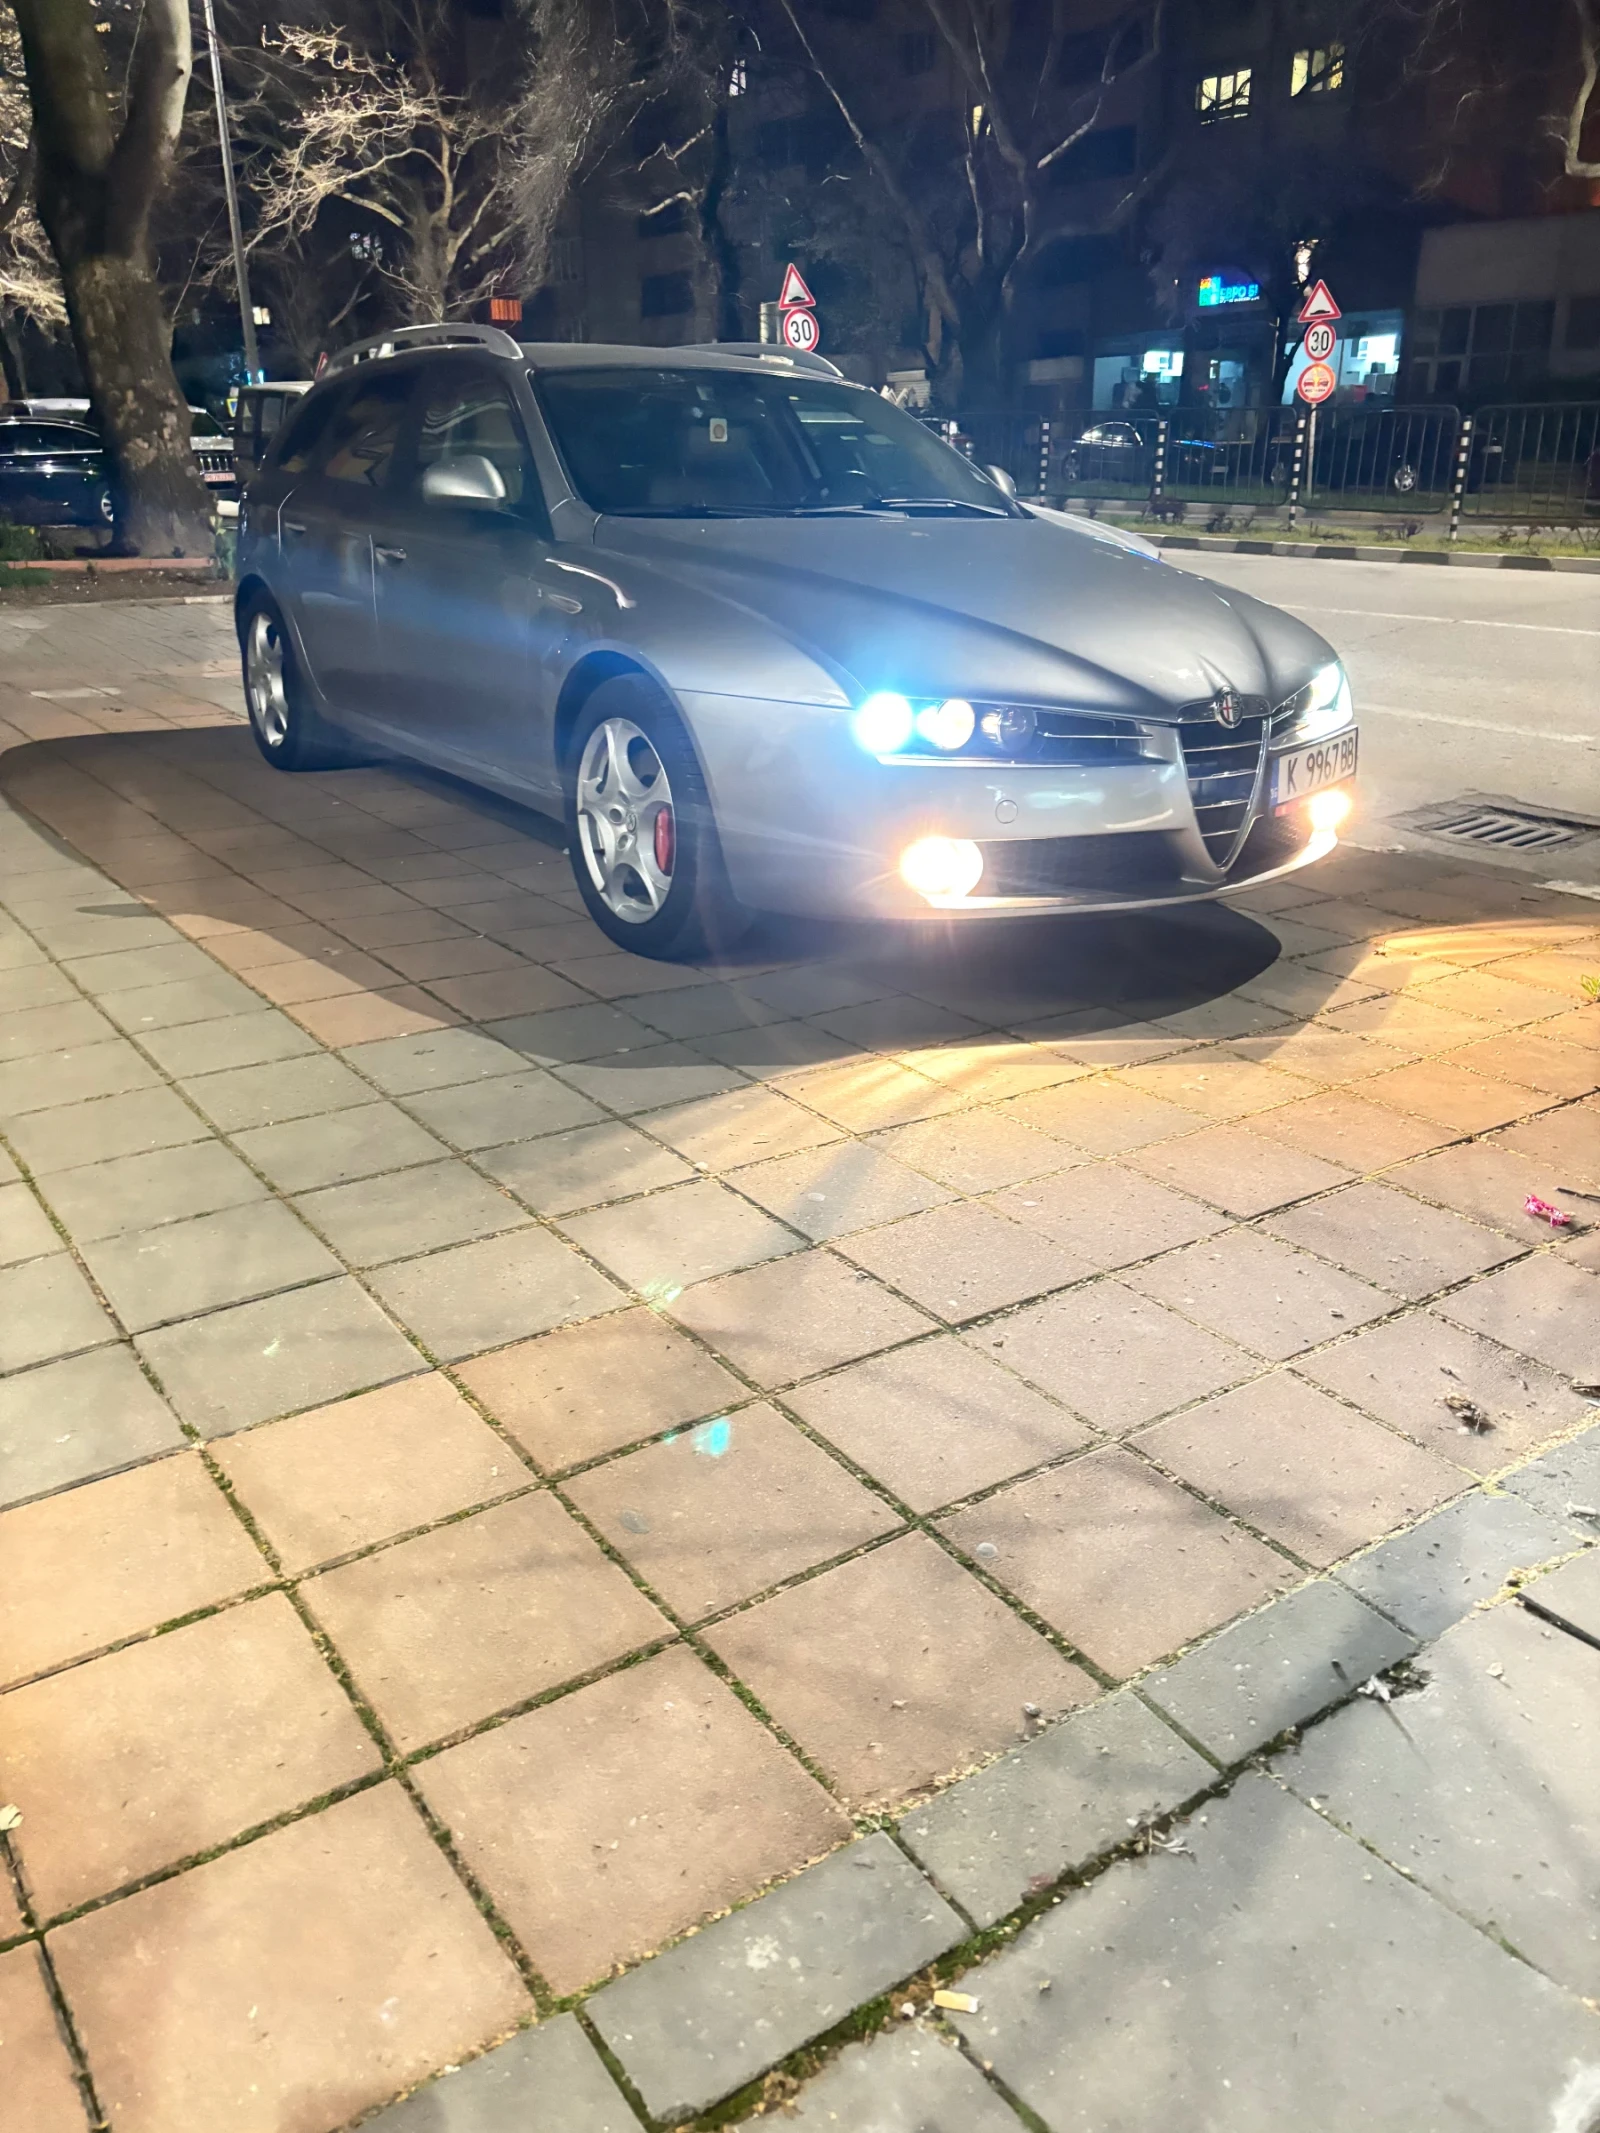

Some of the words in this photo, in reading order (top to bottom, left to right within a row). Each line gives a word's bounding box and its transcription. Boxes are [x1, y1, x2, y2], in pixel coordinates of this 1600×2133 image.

[790, 318, 812, 343] 30
[1311, 330, 1330, 352] 30
[1287, 757, 1298, 795] K
[1306, 743, 1339, 787] 9967
